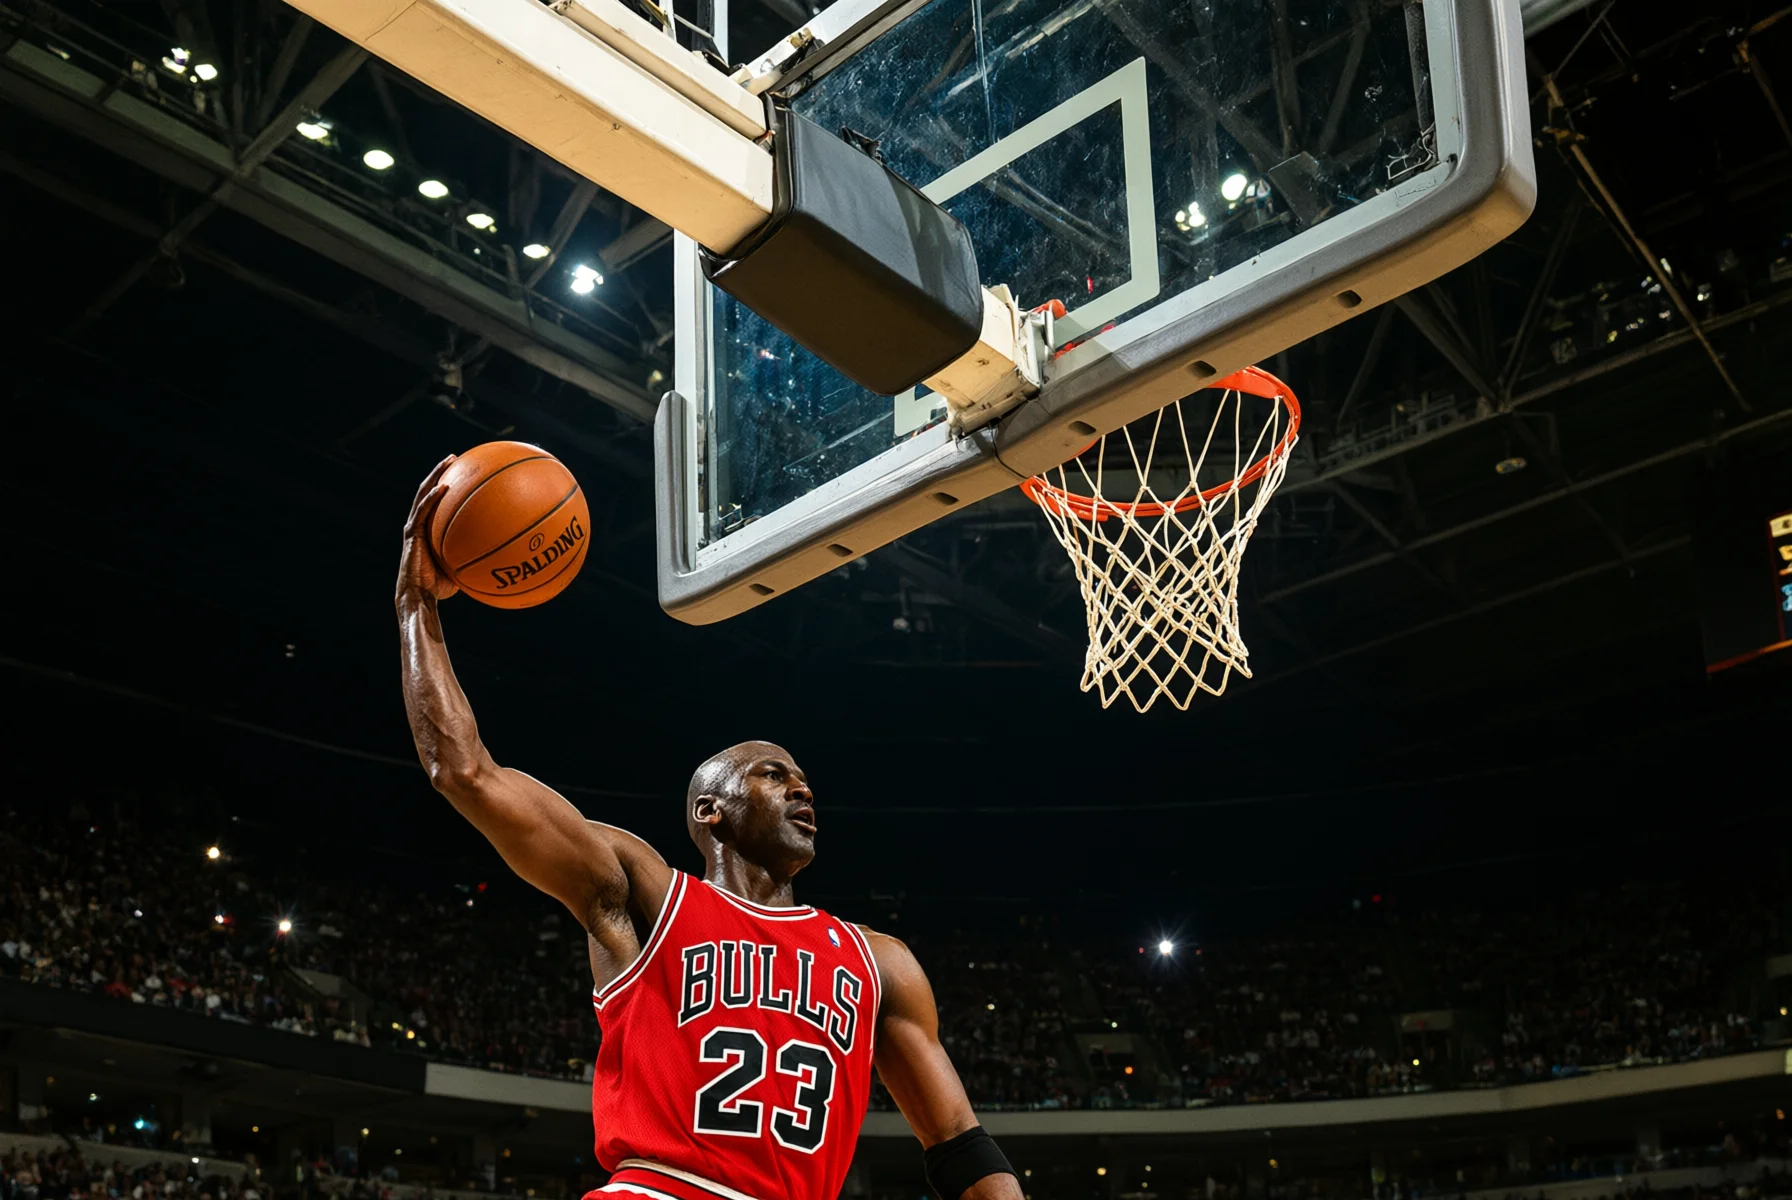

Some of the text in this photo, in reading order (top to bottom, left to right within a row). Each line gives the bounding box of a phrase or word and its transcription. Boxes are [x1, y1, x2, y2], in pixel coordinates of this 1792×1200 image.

[491, 516, 584, 589] SPALDING
[678, 940, 862, 1055] BULLS
[694, 1026, 837, 1154] 23
